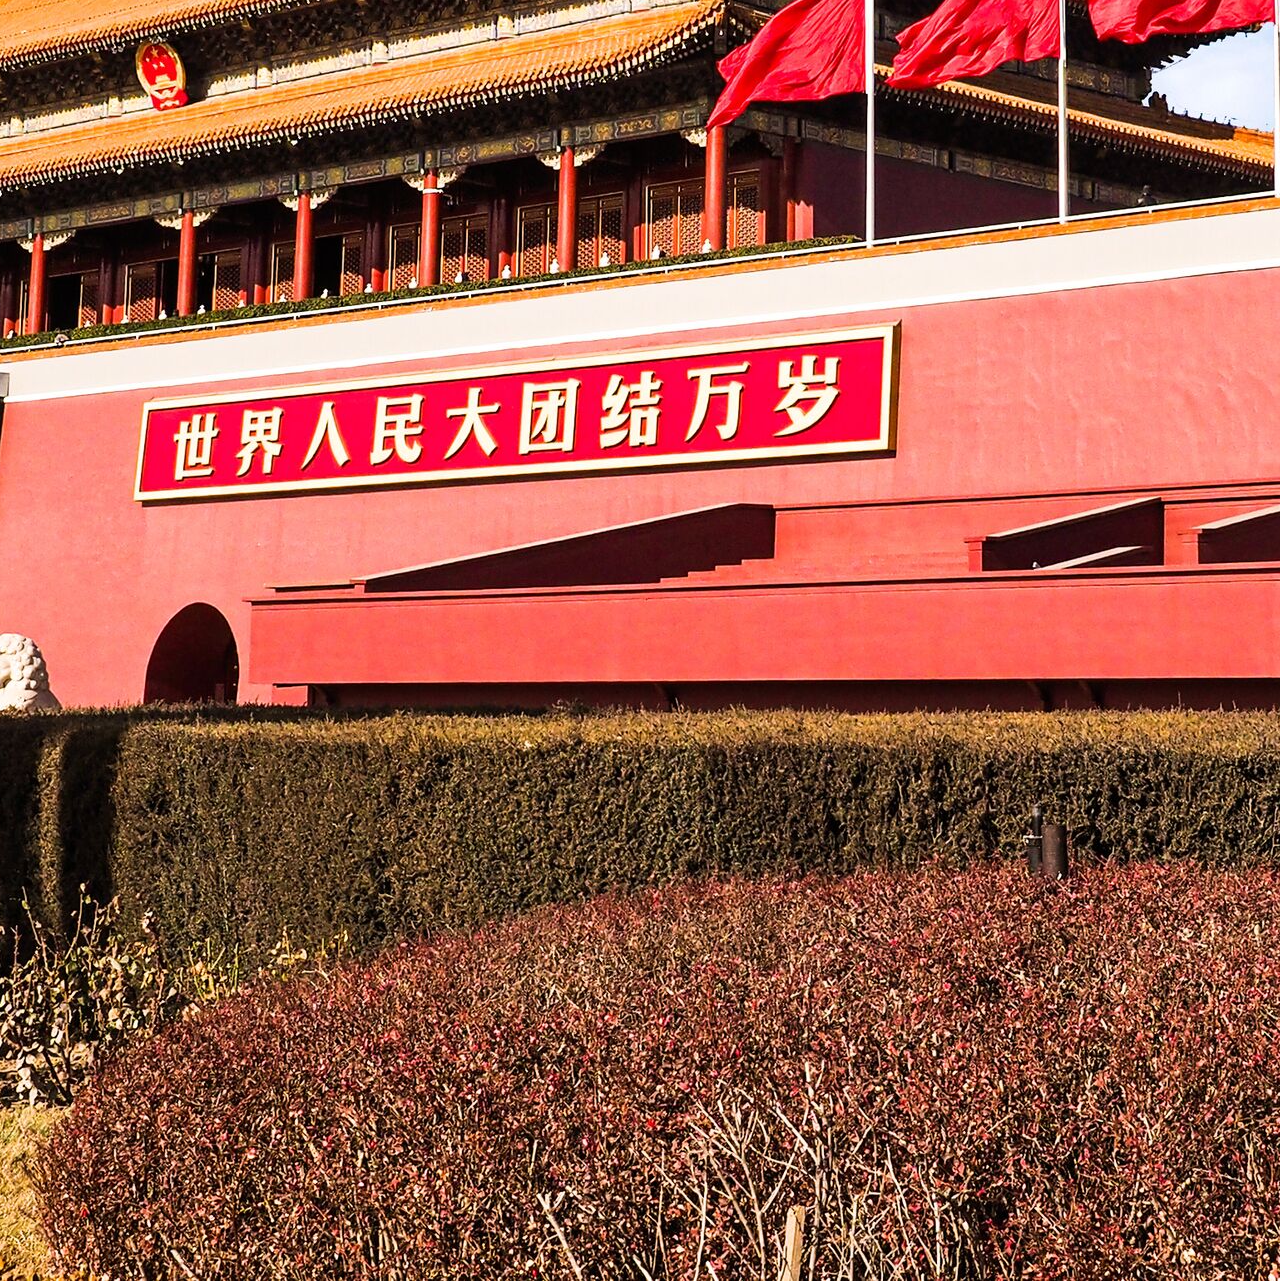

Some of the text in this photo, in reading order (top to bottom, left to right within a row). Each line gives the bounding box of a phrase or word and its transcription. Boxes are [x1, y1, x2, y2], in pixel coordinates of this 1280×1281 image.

[173, 355, 841, 481] 世界人民大团结万岁
